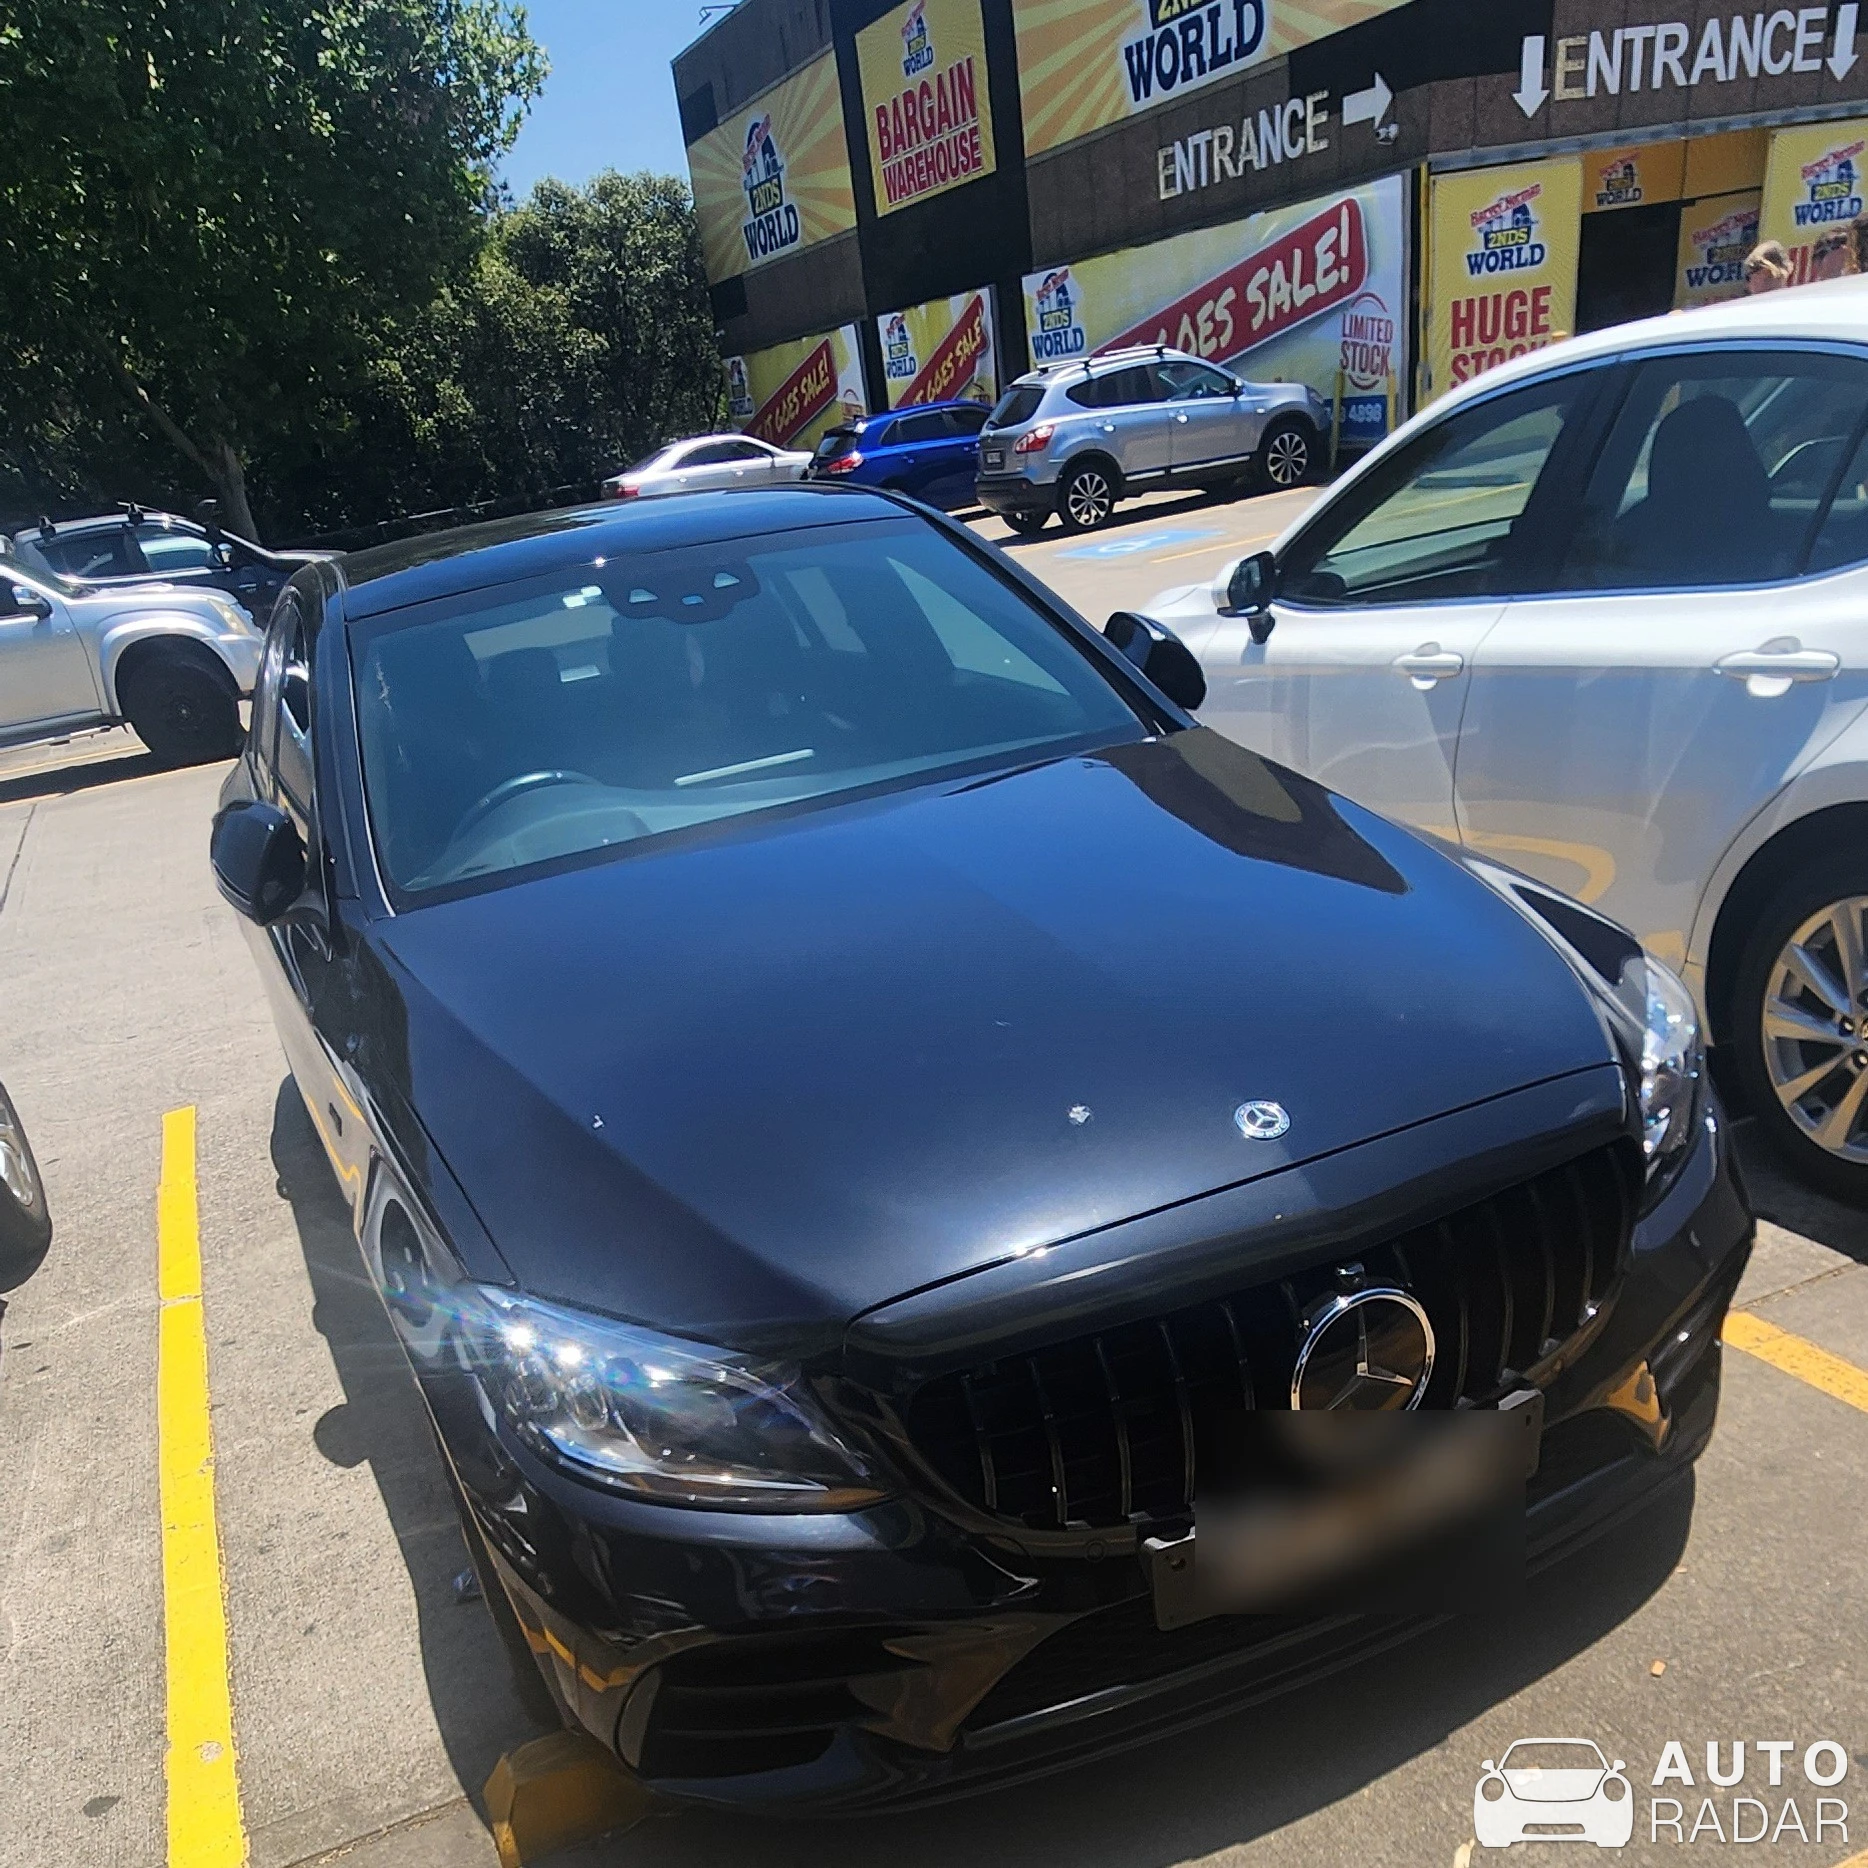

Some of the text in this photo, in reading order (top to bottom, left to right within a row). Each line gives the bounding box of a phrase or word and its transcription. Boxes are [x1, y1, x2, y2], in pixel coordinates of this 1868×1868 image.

[903, 46, 933, 76] WORLD
[1125, 0, 1264, 101] WORLD
[1555, 7, 1828, 100] ENTRANCE
[875, 55, 978, 163] BARGAIN
[882, 125, 984, 205] WAREHOUSE
[1158, 90, 1330, 200] ENTRANCE
[752, 179, 781, 215] 2NDS
[1795, 198, 1862, 225] WORLD
[744, 204, 799, 260] WORLD
[1488, 227, 1528, 249] 2NDS
[1466, 243, 1545, 275] WORLD
[1686, 262, 1743, 287] WOR
[1158, 205, 1349, 358] OES SALE!
[1342, 313, 1393, 343] LIMITED
[1451, 286, 1551, 349] HUGE
[1032, 326, 1084, 359] WORLD
[1340, 340, 1391, 376] STOCK
[1450, 341, 1547, 389] STO
